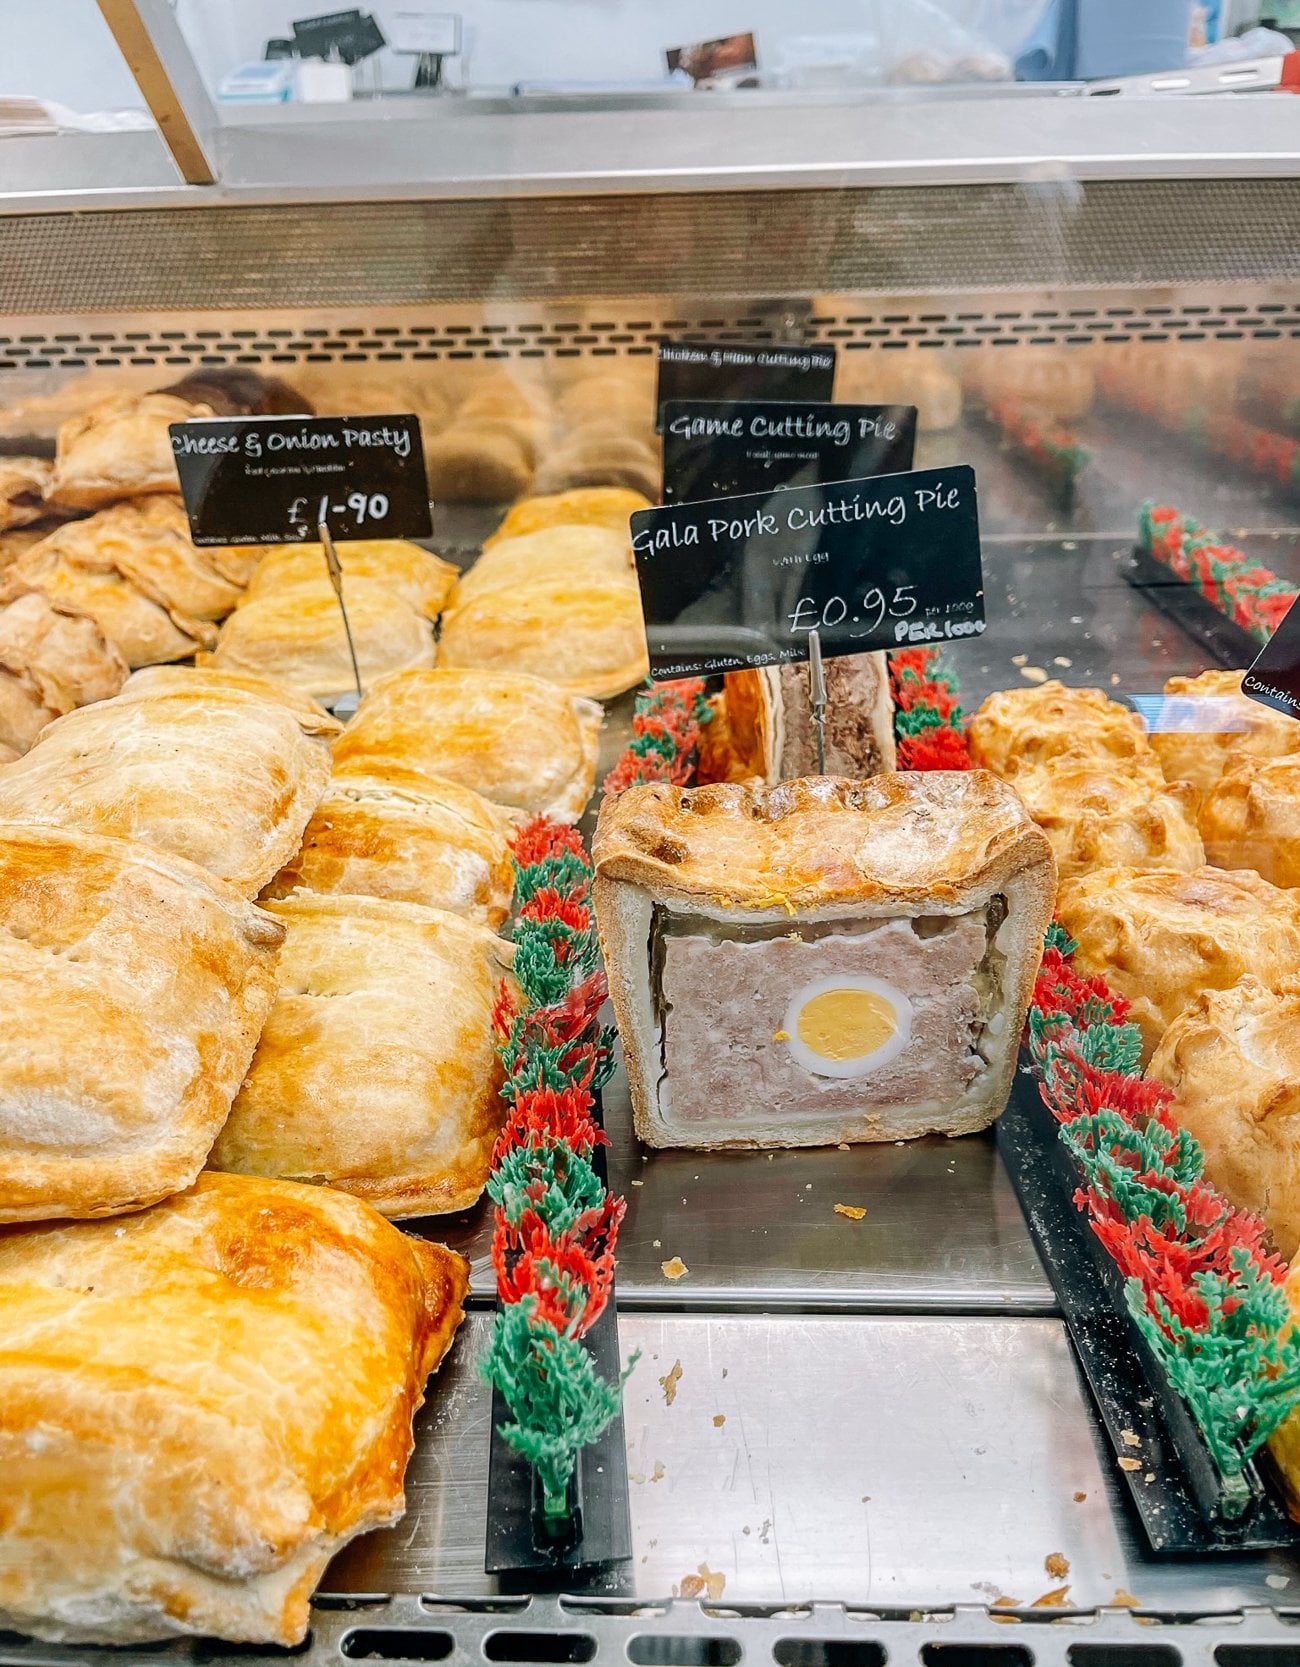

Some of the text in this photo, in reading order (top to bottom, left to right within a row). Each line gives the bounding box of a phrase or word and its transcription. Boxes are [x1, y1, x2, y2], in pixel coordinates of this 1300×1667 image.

[171, 434, 240, 456] Cheese
[266, 427, 340, 452] Onion
[343, 428, 411, 457] Pasty
[670, 413, 897, 446] Game Cutting Pie
[631, 481, 961, 557] Gala Pork Cutting Pie
[788, 584, 919, 638] £0.95
[894, 619, 944, 642] PER
[650, 663, 702, 677] Contains:
